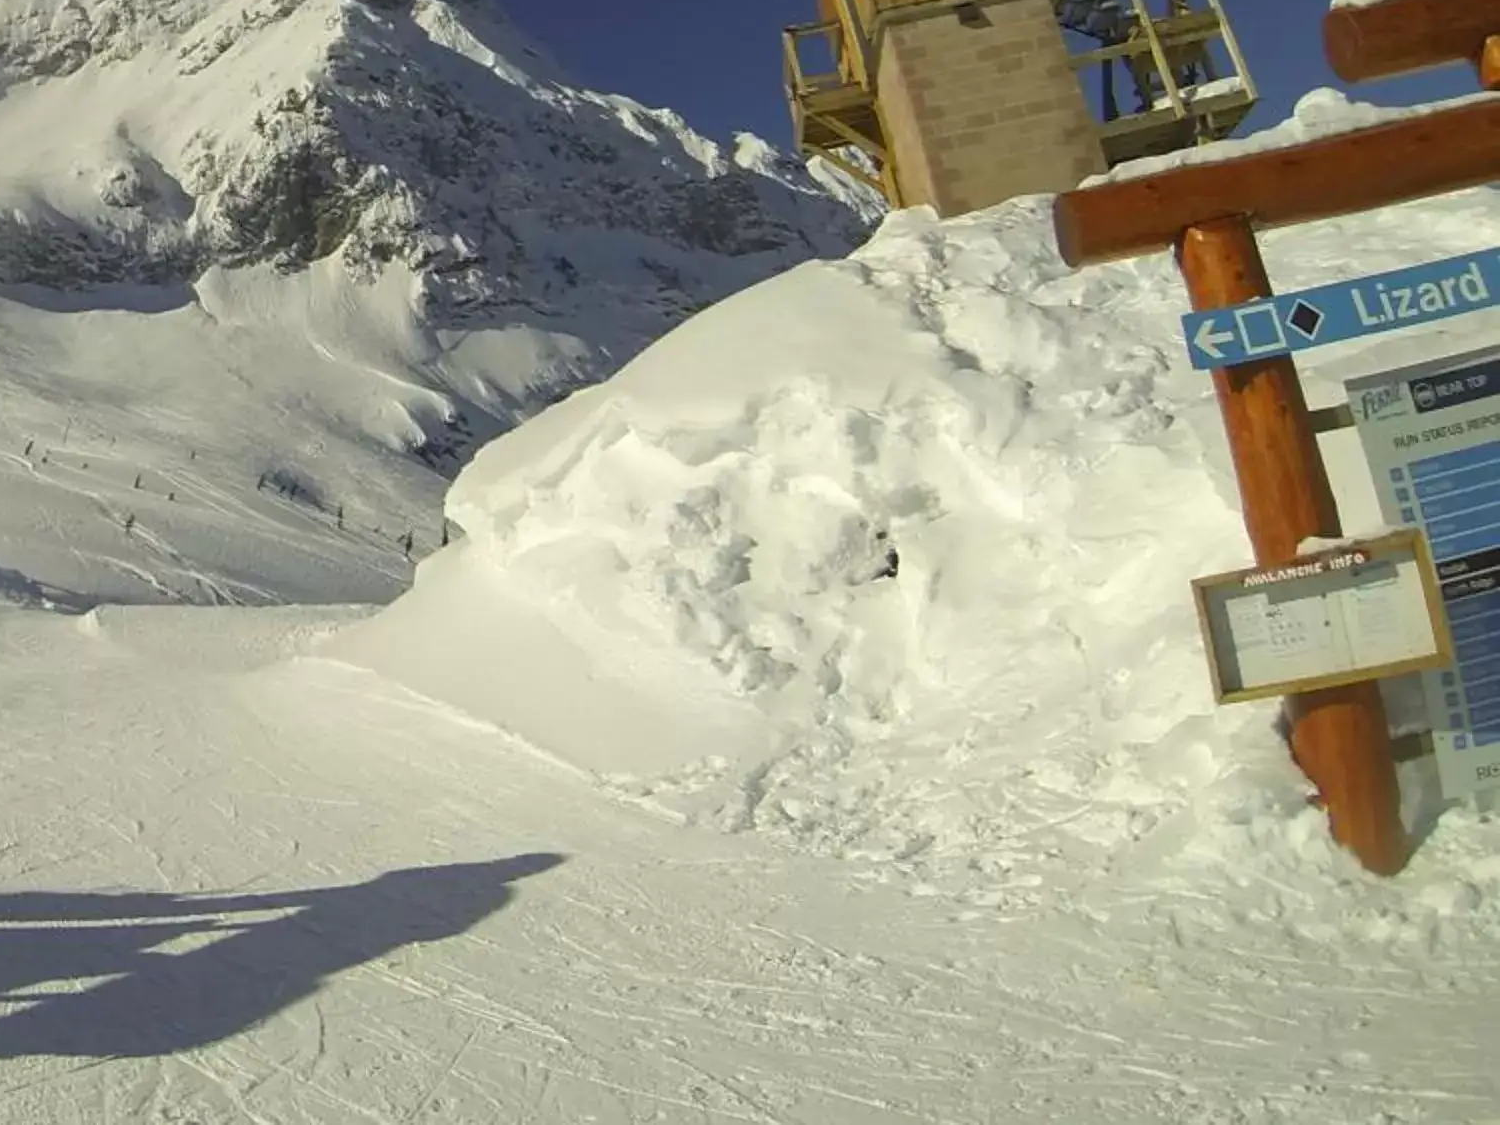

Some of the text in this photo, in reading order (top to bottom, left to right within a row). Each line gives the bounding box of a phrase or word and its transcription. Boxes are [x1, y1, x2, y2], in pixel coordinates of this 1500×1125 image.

[1350, 261, 1490, 327] Lizard
[1421, 422, 1465, 443] STATUS
[1243, 552, 1366, 588] AVALANCHE INFO
